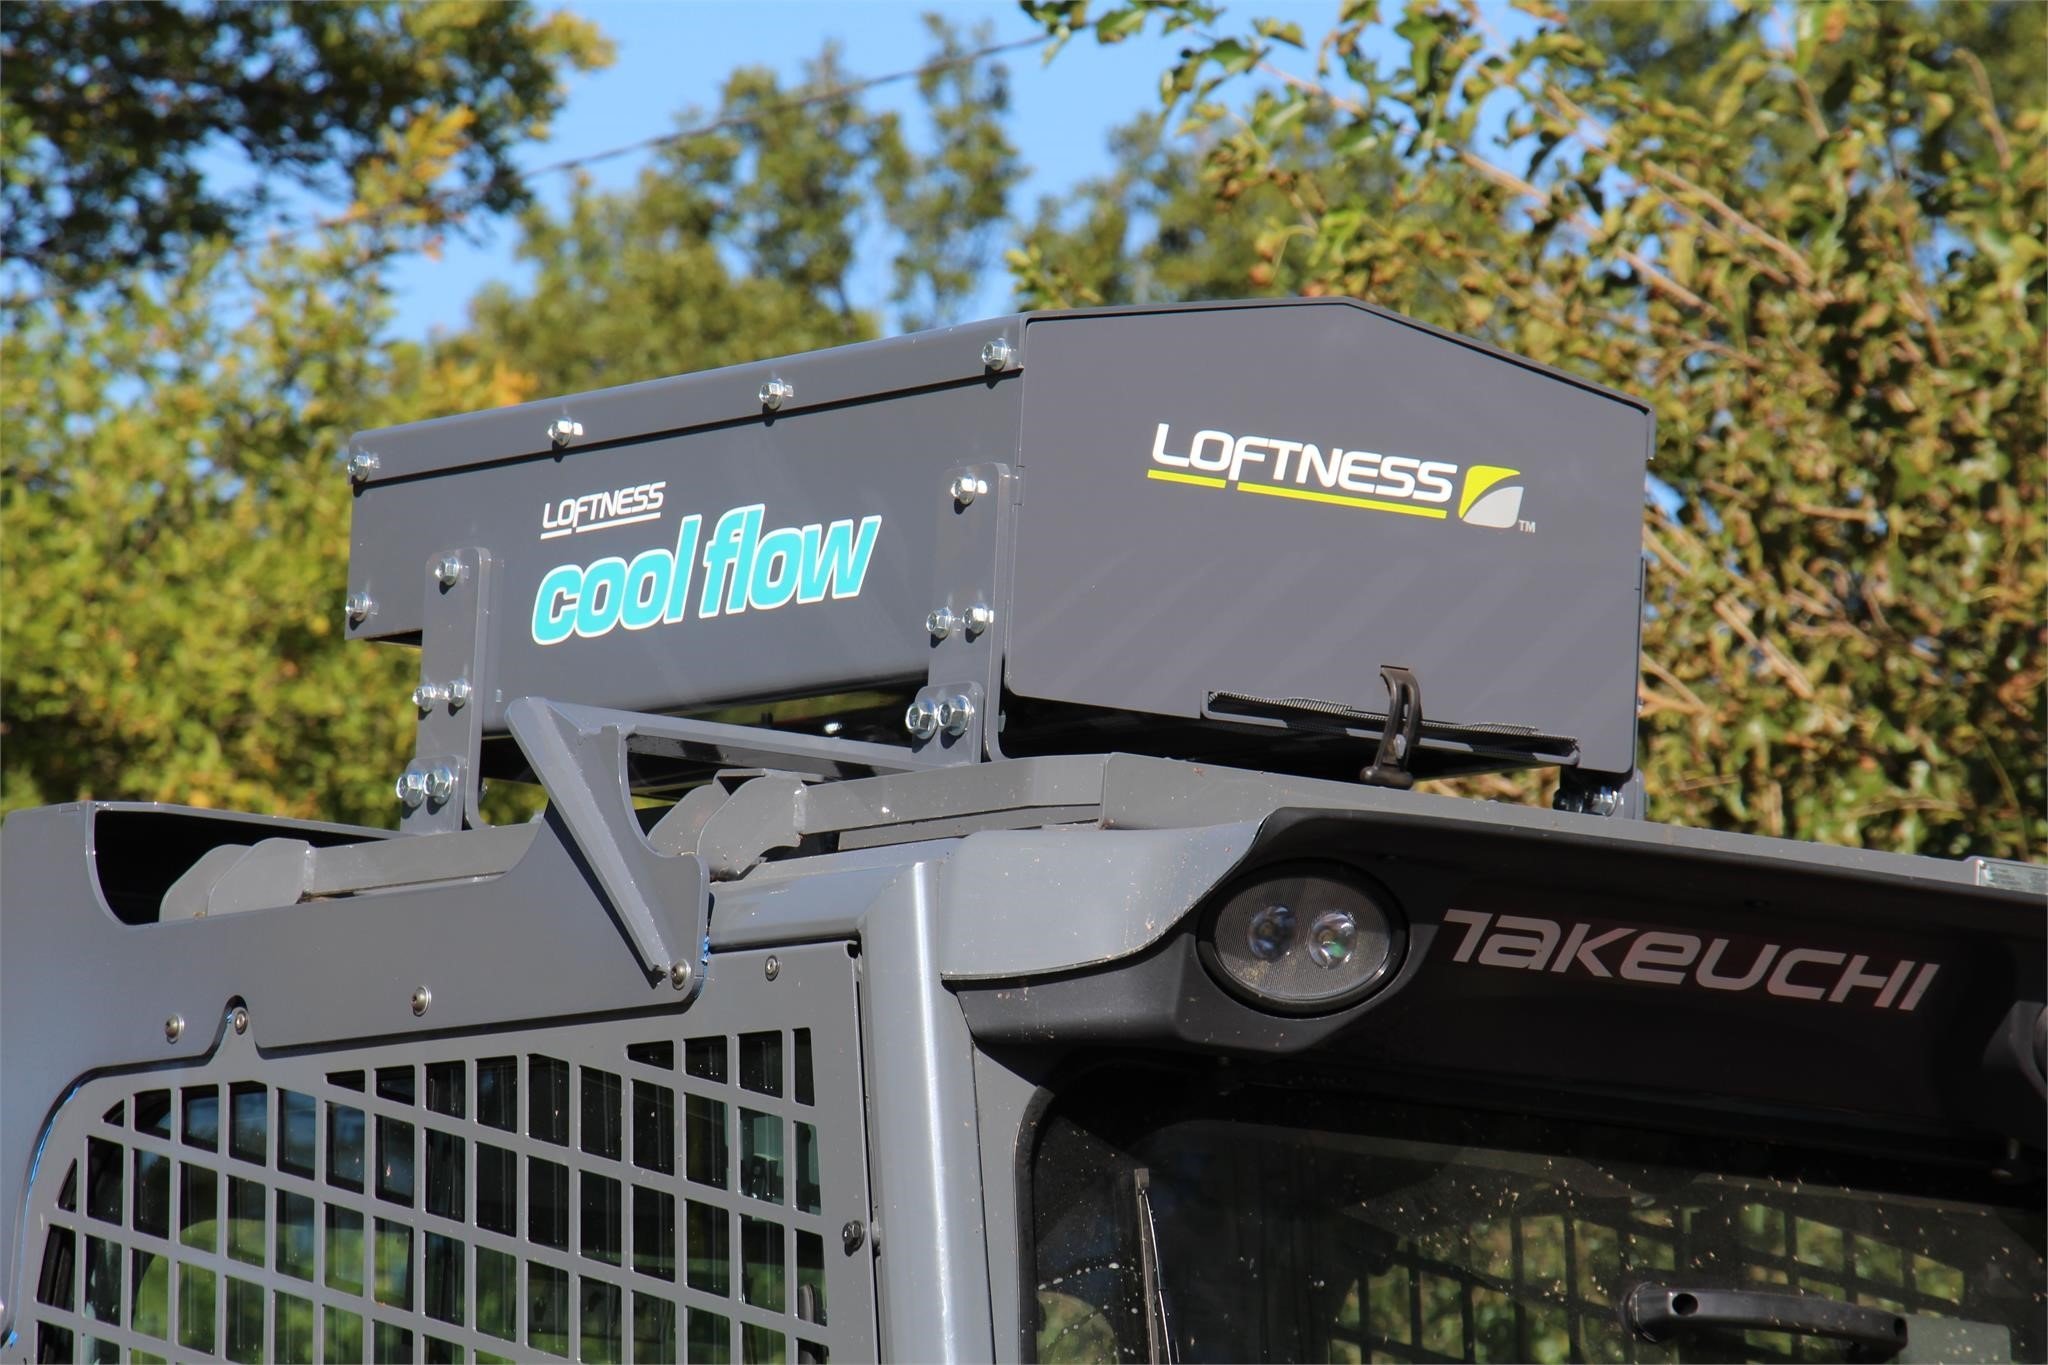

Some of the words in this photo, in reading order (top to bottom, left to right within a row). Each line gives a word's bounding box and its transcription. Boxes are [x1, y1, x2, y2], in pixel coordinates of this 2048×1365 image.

[542, 481, 667, 530] LOFTNESS
[1151, 422, 1458, 503] LOFTNESS
[1518, 519, 1536, 533] TM
[531, 513, 702, 646] cool
[698, 503, 882, 619] flow
